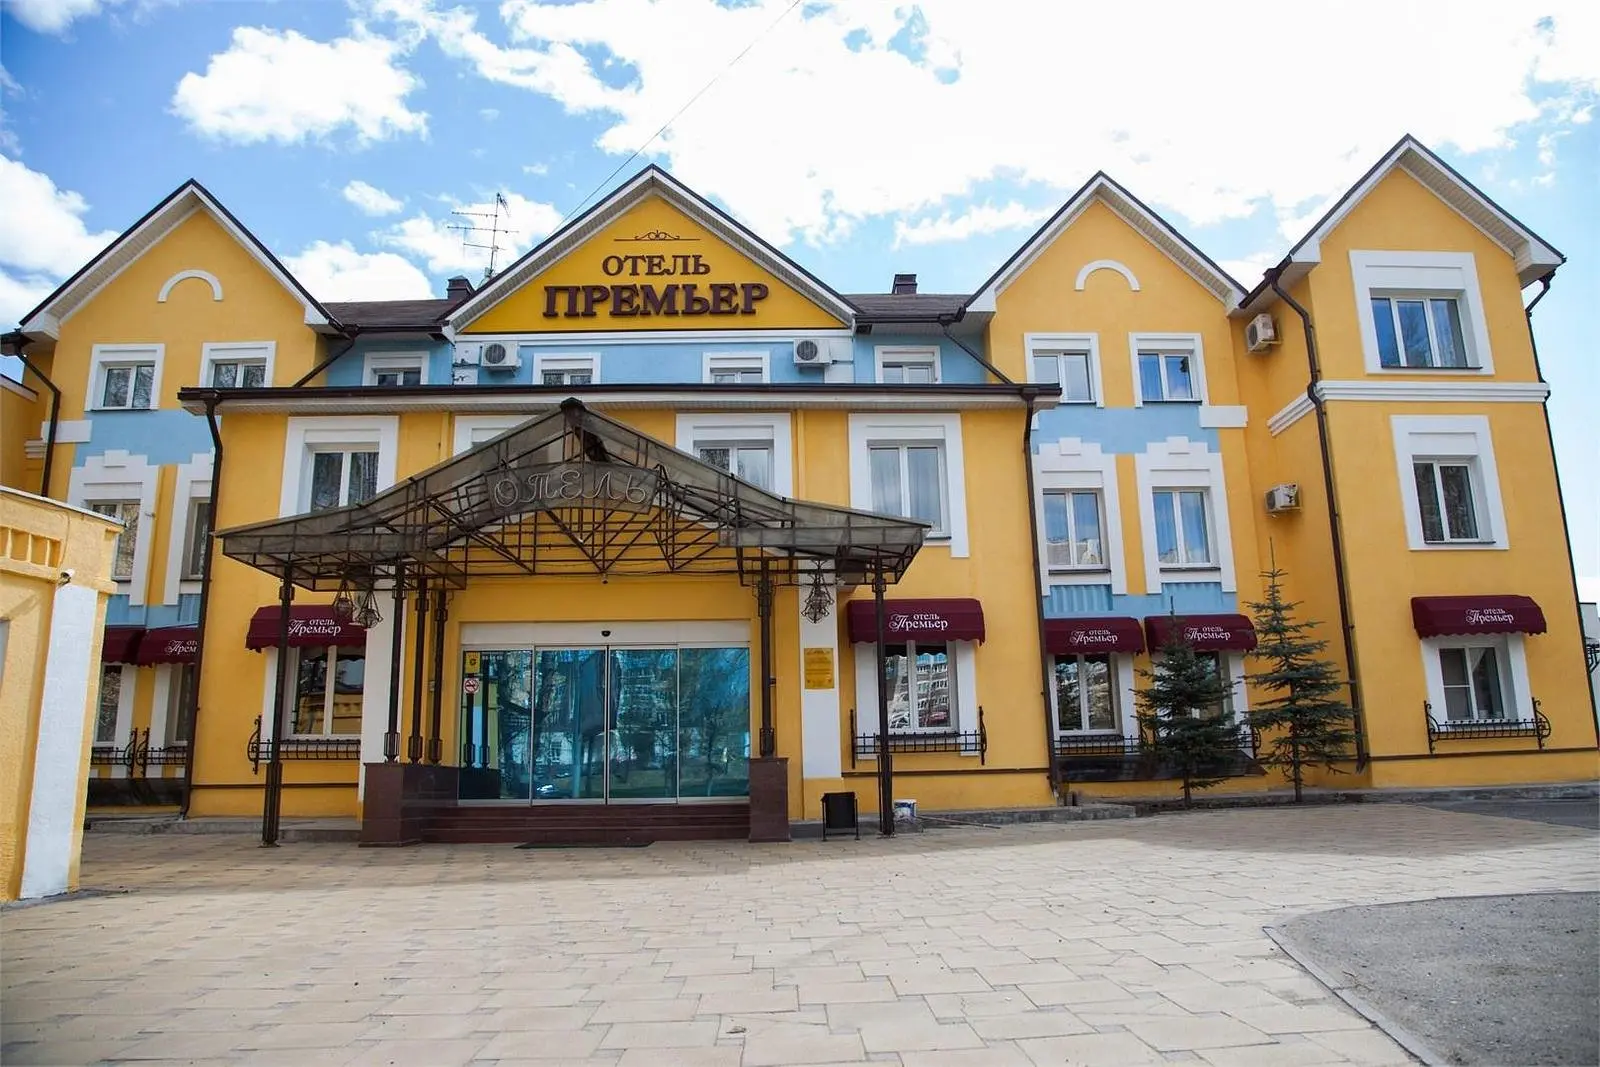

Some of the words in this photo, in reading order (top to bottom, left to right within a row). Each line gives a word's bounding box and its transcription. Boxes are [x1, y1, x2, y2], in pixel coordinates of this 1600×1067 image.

[602, 255, 711, 276] ОТЕЛЬ
[543, 283, 770, 317] ПРЕМЬЕР
[309, 618, 335, 626] отель
[888, 614, 948, 632] Премьер
[913, 613, 940, 621] отель
[1466, 609, 1514, 625] Премьер
[288, 620, 341, 636] Премьер
[1183, 627, 1231, 642] Премьер
[1069, 631, 1118, 645] Премьер
[165, 640, 198, 655] Прем
